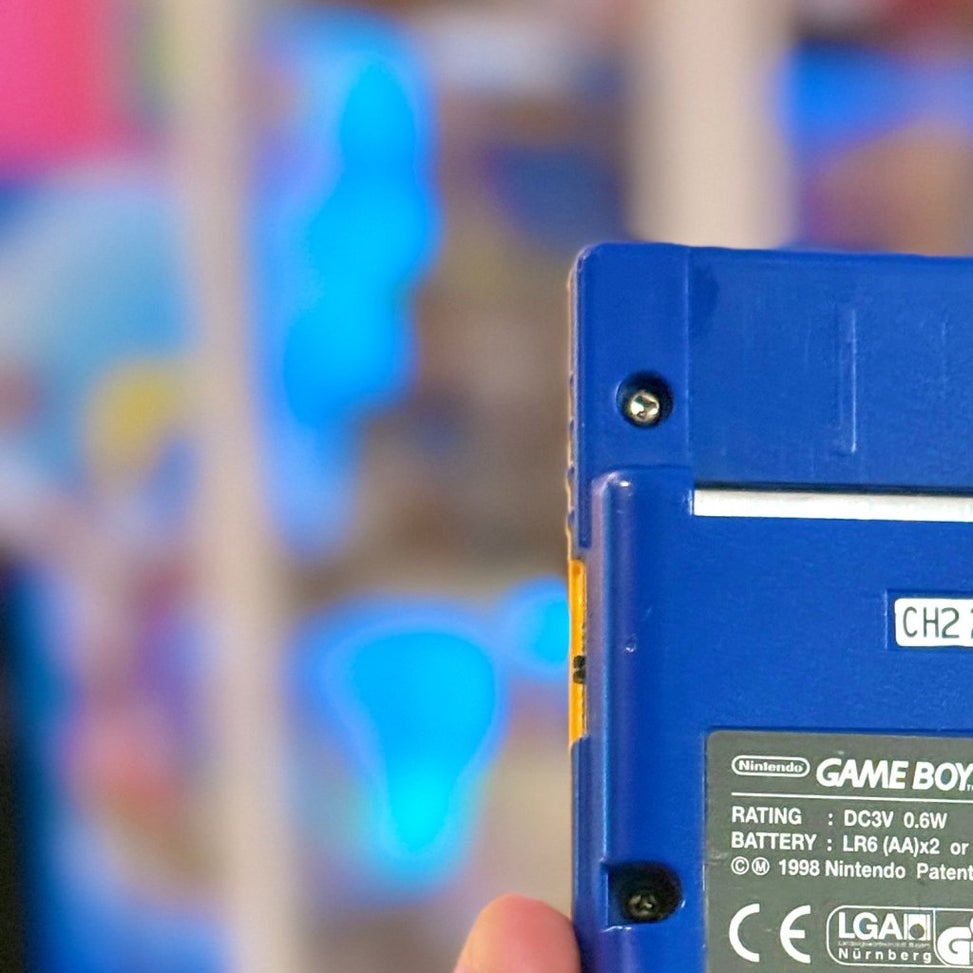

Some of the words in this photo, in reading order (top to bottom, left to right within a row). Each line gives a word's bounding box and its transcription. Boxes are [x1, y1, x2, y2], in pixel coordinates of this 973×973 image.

[737, 761, 804, 774] Nintendo
[816, 758, 908, 789] GAME
[731, 806, 803, 825] RATING
[844, 810, 893, 827] DC3V
[903, 812, 948, 829] 0.6W
[731, 832, 817, 851] BATTERY
[843, 836, 878, 853] LR6
[883, 836, 940, 857] (AA)x2
[950, 842, 969, 856] or
[779, 859, 820, 877] 1998
[825, 861, 906, 879] Nintendo
[838, 912, 901, 940] LGA
[838, 947, 932, 964] Nürnberg
